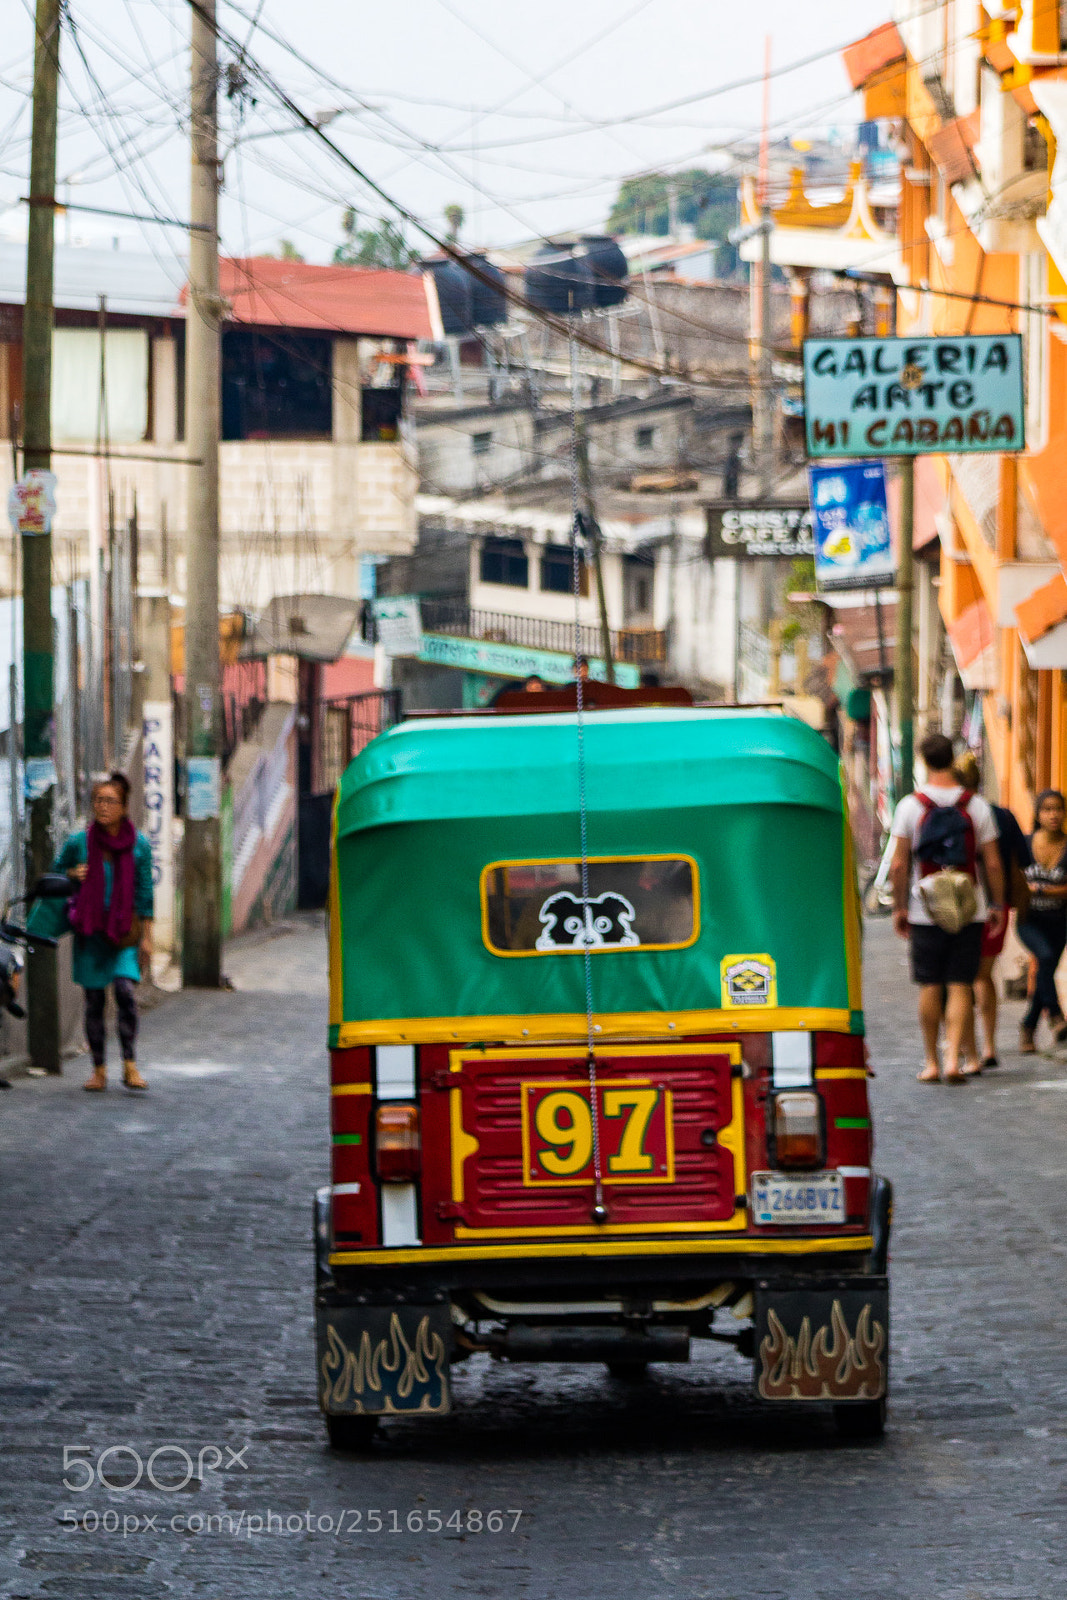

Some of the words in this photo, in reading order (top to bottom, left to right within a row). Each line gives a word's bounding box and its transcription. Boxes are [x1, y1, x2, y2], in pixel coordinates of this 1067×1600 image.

[812, 342, 1009, 377] GALERIA
[865, 410, 1016, 448] CABAÑA
[534, 1088, 659, 1177] 97
